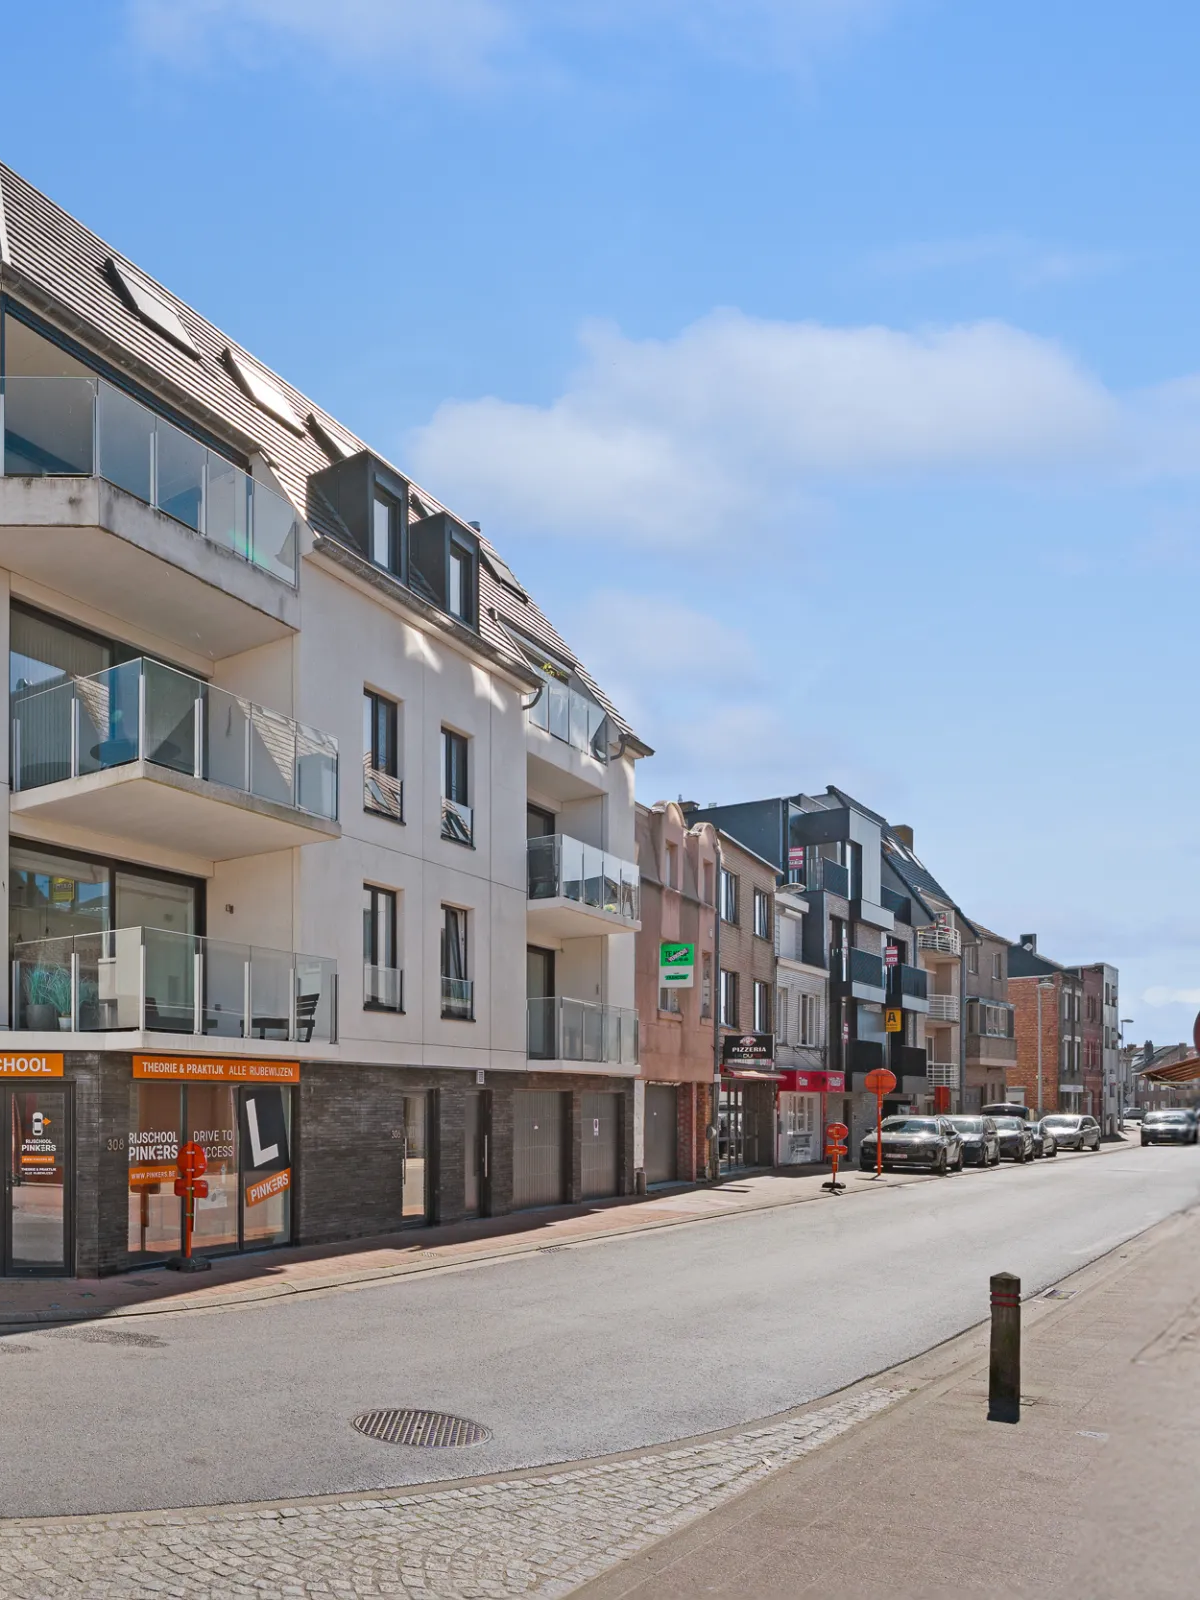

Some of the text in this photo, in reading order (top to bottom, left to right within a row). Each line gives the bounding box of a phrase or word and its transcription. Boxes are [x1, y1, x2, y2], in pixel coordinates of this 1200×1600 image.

[142, 1062, 293, 1077] THEORIE & PRAKTIJK ALLE RIJBEWIJZEN
[128, 1131, 178, 1144] RIJSCHOOL
[193, 1129, 233, 1142] DRIVE TO
[246, 1098, 279, 1168] L
[21, 1144, 57, 1152] PINKERS
[107, 1138, 125, 1151] 308
[128, 1144, 178, 1161] PINKERS
[204, 1145, 233, 1158] CCESS
[131, 1170, 176, 1179] WWW.PINKERS.BE
[250, 1173, 289, 1202] PINKERS
